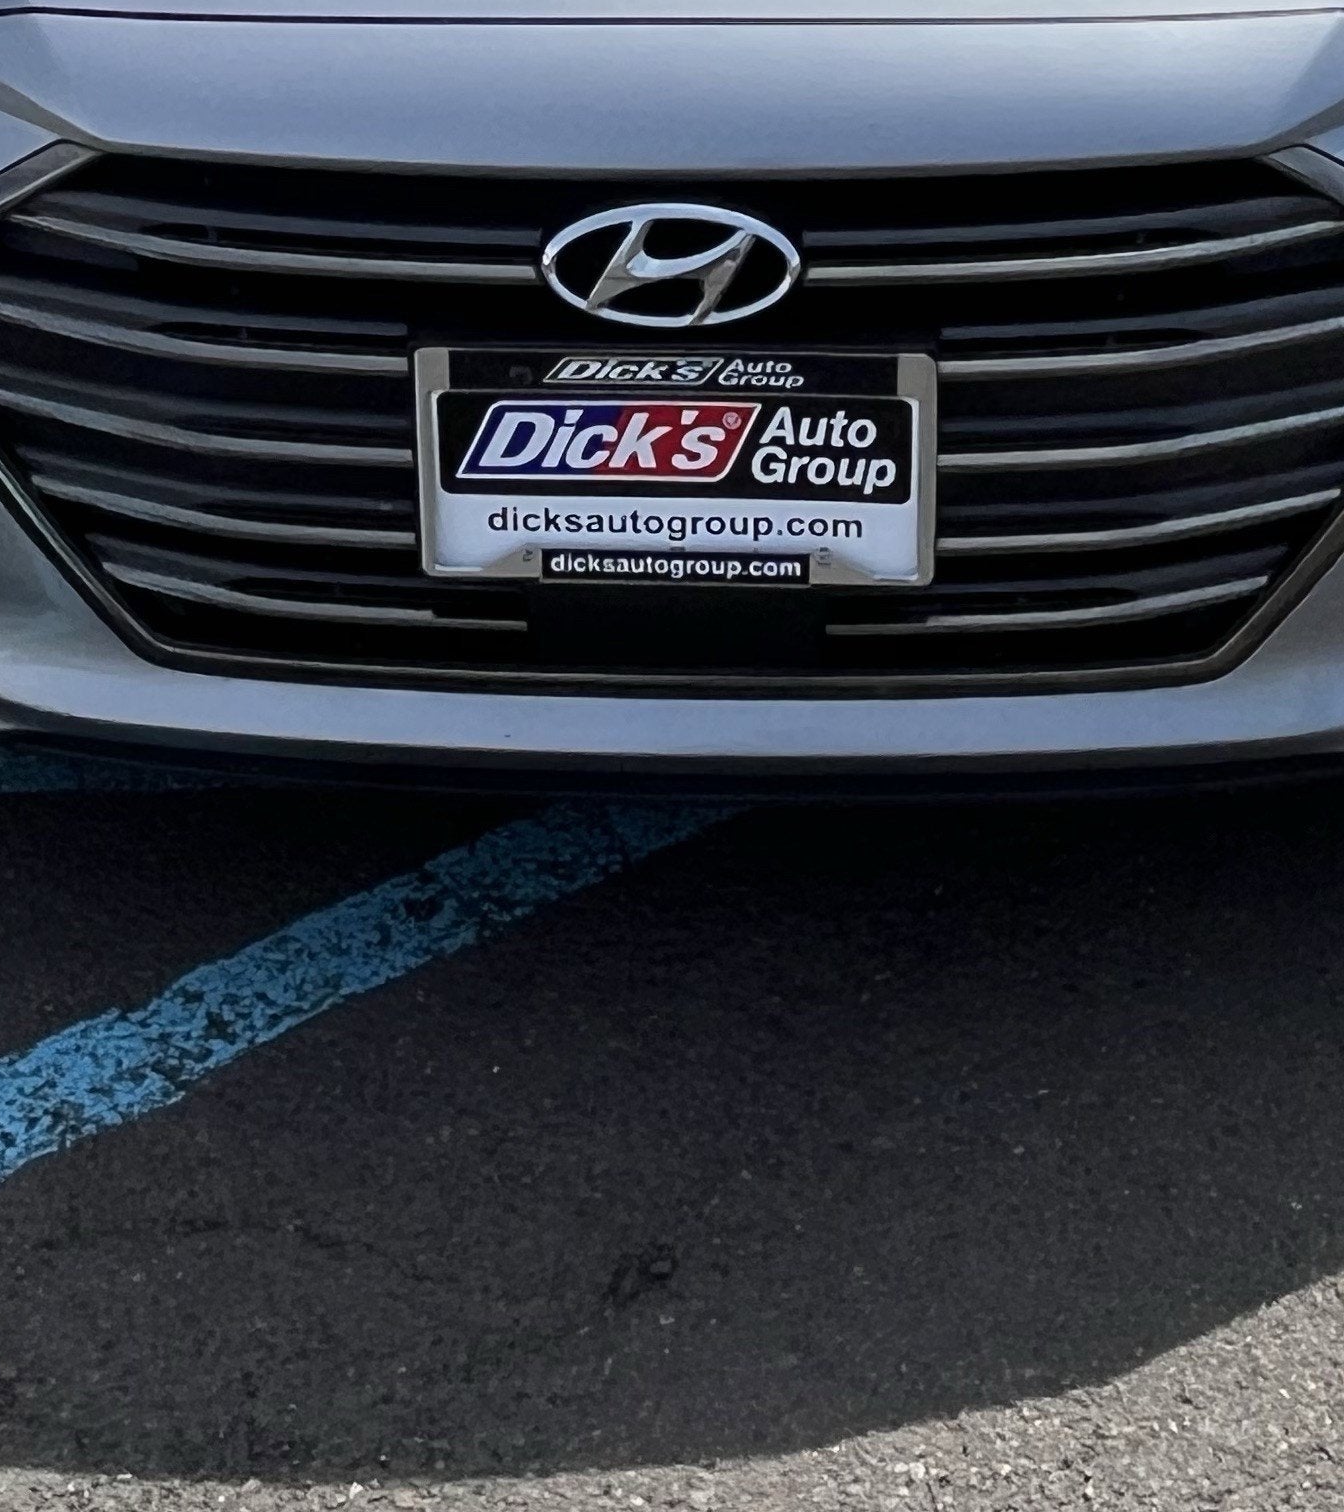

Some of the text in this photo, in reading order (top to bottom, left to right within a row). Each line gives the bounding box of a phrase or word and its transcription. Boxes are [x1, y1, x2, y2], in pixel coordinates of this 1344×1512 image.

[557, 359, 793, 381] Dick's Auto
[718, 371, 805, 388] Group
[478, 407, 878, 470] Dick's Auto
[751, 447, 896, 494] Group
[487, 507, 864, 541] dicksautogroup.com
[550, 553, 801, 579] dicksautogroup.com
